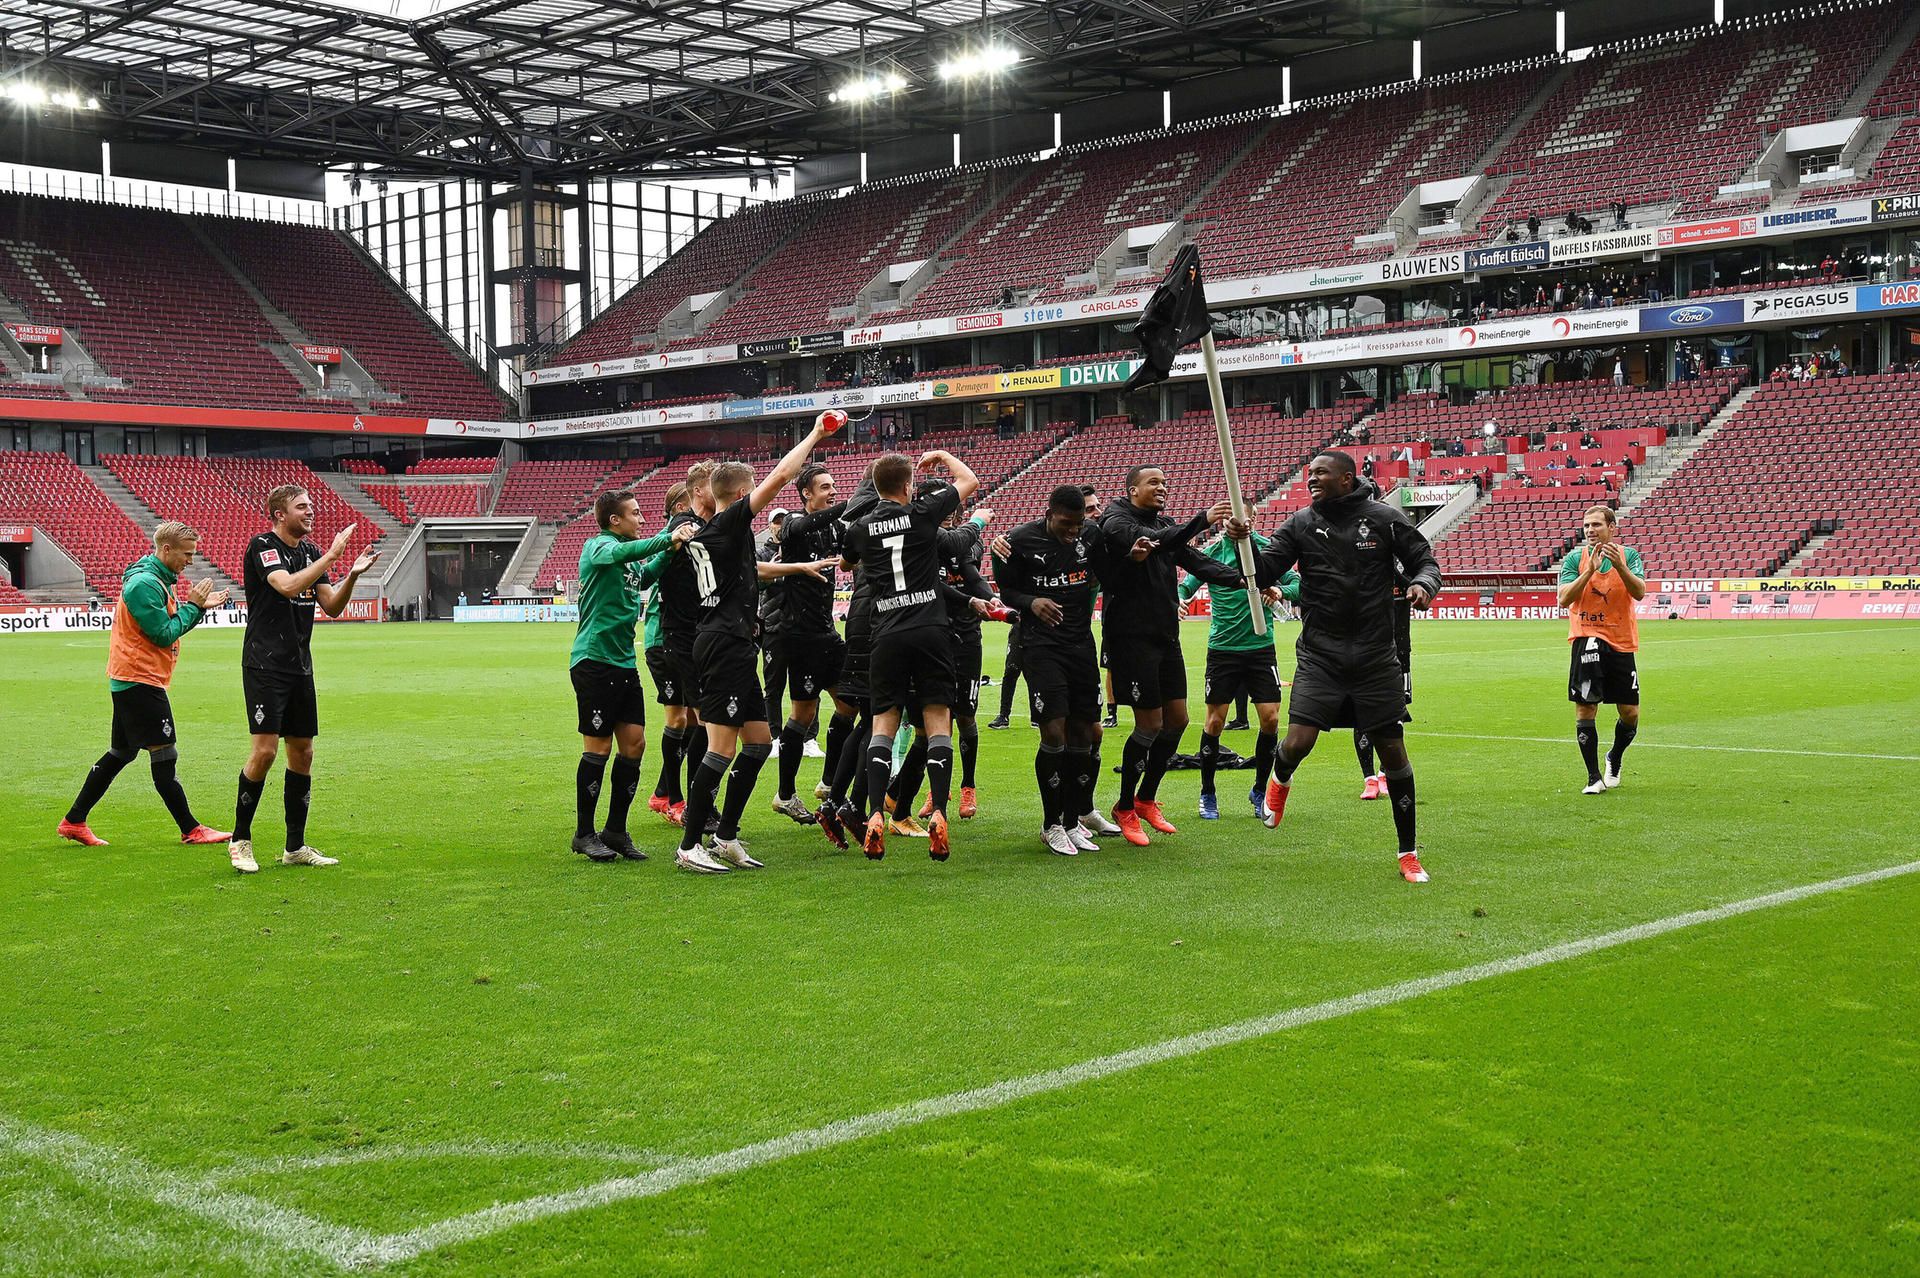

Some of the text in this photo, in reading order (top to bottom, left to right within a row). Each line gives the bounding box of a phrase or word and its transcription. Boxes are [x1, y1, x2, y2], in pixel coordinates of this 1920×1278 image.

[1763, 208, 1837, 228] LIEBHERR
[1877, 210, 1918, 220] TEXTILDRUCK
[1552, 240, 1590, 257] GAFFELS
[1592, 233, 1652, 252] FASSBRAUSE
[1479, 246, 1545, 266] Gaffel Kölsch
[1382, 255, 1460, 279] BAUWENS
[1309, 273, 1364, 287] dillenburger
[1080, 298, 1138, 314] CARGLASS
[1773, 291, 1849, 310] PEGASUS
[1024, 307, 1063, 323] stewe
[1677, 308, 1704, 323] Ford
[957, 315, 999, 331] REMONDIS
[1572, 319, 1629, 332] RheinEnergie
[1479, 327, 1531, 340] RheinEnergie
[1367, 336, 1443, 351] Kreissparkasse Köln
[1216, 352, 1280, 365] rkasse KölnBonn
[1069, 363, 1120, 385] DEVK
[1170, 361, 1197, 372] ologne
[955, 381, 988, 393] Remagen
[1013, 374, 1055, 386] RENAULT
[765, 398, 814, 411] SIEGENIA
[880, 390, 919, 404] sunzinet
[467, 425, 501, 434] RheinEnergie
[566, 415, 633, 431] RheinEnergieSTADION
[868, 514, 912, 537] HERRMANN
[882, 534, 907, 592] 7
[1455, 578, 1475, 586] REWE
[1478, 578, 1499, 586] REWE
[1527, 577, 1548, 585] REWE
[876, 589, 937, 613] MÖNCHENGLADBACH
[1862, 603, 1906, 613] REWE
[347, 601, 373, 618] MARKT
[1409, 607, 1559, 619] EWE REWE REWE REWE
[1579, 611, 1605, 622] flat
[65, 613, 112, 630] uhlsp
